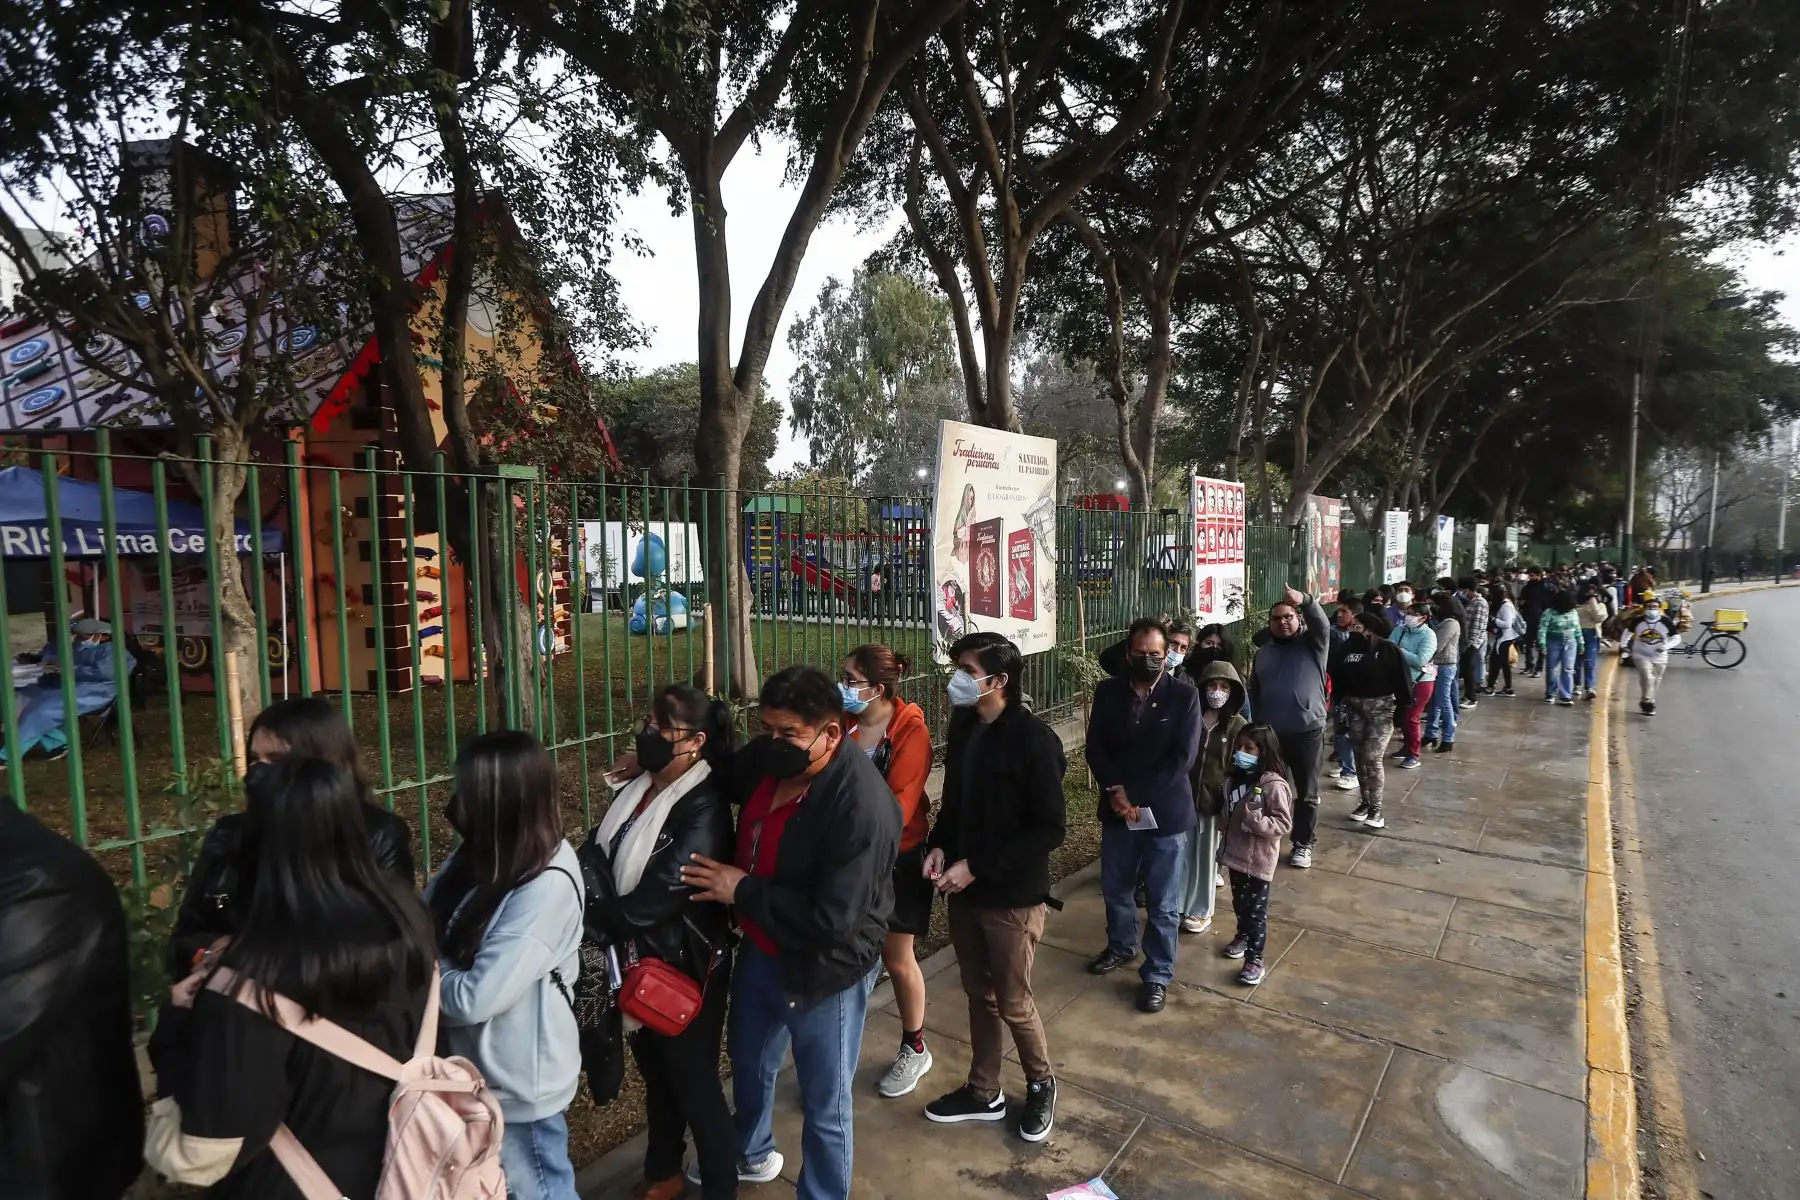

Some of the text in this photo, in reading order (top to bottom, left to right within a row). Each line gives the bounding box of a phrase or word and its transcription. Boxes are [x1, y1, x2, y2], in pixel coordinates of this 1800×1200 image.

[953, 438, 995, 460] Tradiciones
[965, 459, 1000, 474] peruanas
[75, 528, 159, 554] Lima
[167, 528, 254, 553] Cero
